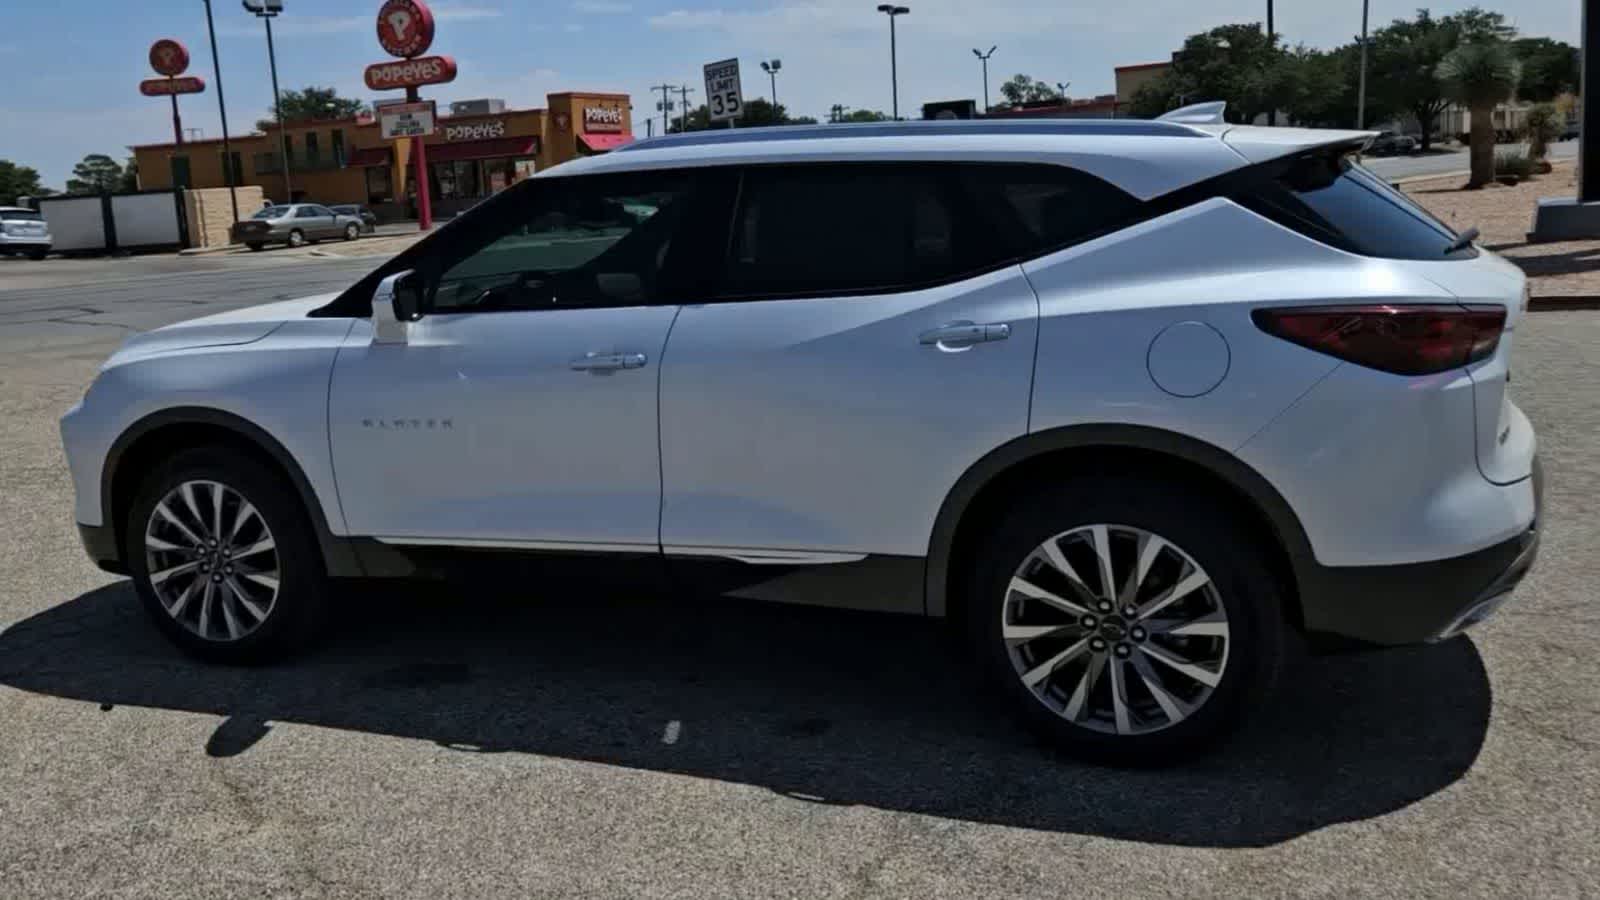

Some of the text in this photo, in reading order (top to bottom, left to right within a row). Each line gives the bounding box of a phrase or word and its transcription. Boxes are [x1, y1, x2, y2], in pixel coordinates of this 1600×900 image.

[388, 11, 411, 41] P
[706, 65, 737, 80] SPEED
[710, 78, 734, 93] LIMIT
[712, 92, 739, 115] 35
